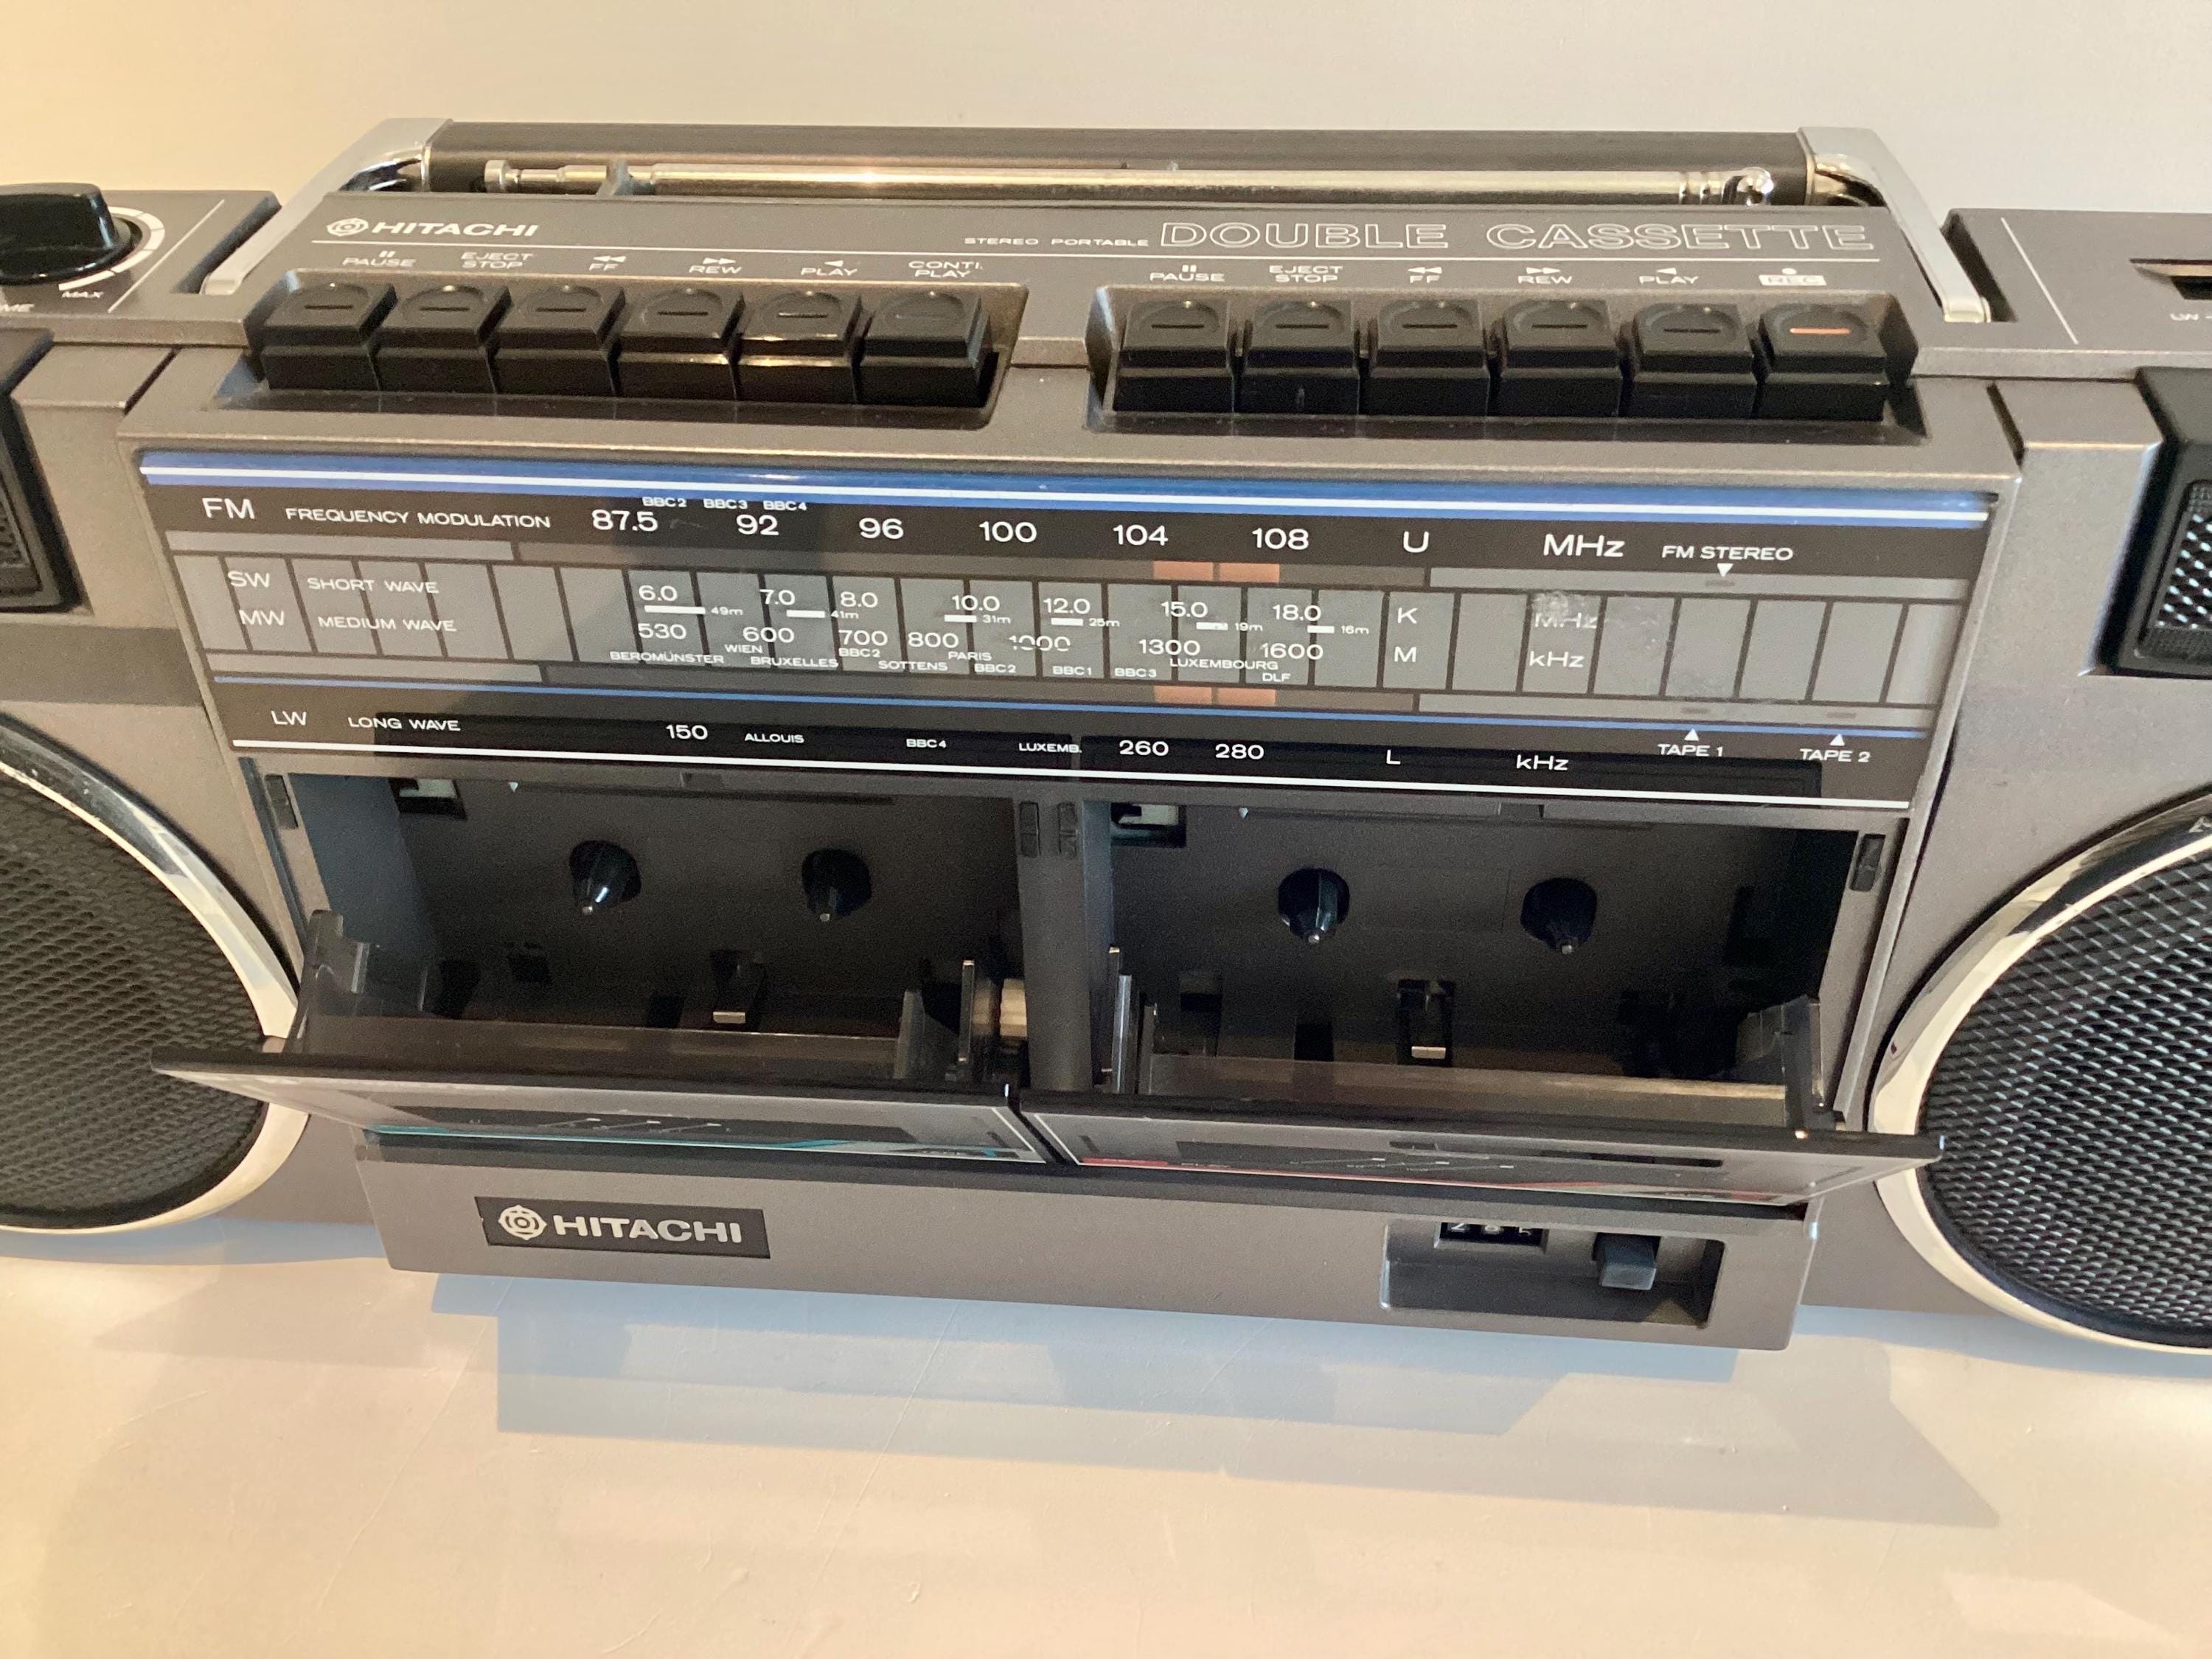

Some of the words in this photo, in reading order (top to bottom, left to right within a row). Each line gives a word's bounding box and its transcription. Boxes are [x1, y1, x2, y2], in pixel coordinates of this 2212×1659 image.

[372, 220, 540, 237] HITACHI
[1160, 221, 1449, 248] DOUBLE
[1486, 223, 1874, 250] CASSETTE
[964, 237, 1040, 245] STEREO
[1051, 238, 1149, 246] PORTABLE
[342, 257, 416, 268] PAUSE
[461, 251, 533, 261] EJECT
[462, 260, 523, 269] STOP
[589, 262, 617, 271] FF
[689, 265, 742, 274] REW
[800, 267, 858, 277] PLAY
[1269, 265, 1343, 274] EJECT
[914, 269, 971, 279] PLAY
[1150, 272, 1225, 282] PAUSE
[1274, 274, 1338, 283] STOP
[1410, 274, 1440, 284] FF
[1517, 275, 1573, 285] REW
[1638, 275, 1699, 285] PLAY
[202, 497, 255, 519] FM
[642, 496, 686, 508] BBC2
[703, 498, 748, 509] BBC3
[763, 500, 807, 512] BBC4
[285, 507, 408, 524] FREQUENCY
[417, 512, 551, 529] MODULATION
[591, 509, 658, 532] 87.5
[736, 514, 779, 536] 92
[858, 518, 904, 540] 96
[978, 521, 1037, 543] 100
[1113, 524, 1169, 546] 104
[1252, 528, 1309, 550] 108
[1402, 531, 1429, 554] U
[1543, 534, 1625, 557] MHz
[1662, 545, 1694, 559] FM
[1700, 546, 1793, 560] STEREO
[227, 571, 271, 588] SW
[306, 577, 374, 591] SHORT
[384, 580, 439, 594] WAVE
[638, 585, 678, 602] 6.0
[759, 589, 796, 606] 7.0
[840, 591, 878, 608] 8.0
[952, 594, 1001, 612] 10.0
[1043, 597, 1091, 614] 12.0
[1161, 601, 1208, 619] 15.0
[238, 609, 285, 626] MW
[711, 606, 743, 616] 49m
[830, 610, 859, 619] 41m
[1273, 604, 1321, 622] 18.0
[1397, 607, 1418, 625] K
[318, 616, 397, 630] MEDIUM
[402, 619, 457, 633] WAVE
[982, 614, 1011, 625] 31m
[1089, 617, 1120, 627] 25m
[1234, 622, 1263, 632] 19m
[1534, 612, 1598, 629] MHz
[638, 623, 686, 640] 530
[742, 627, 795, 644] 600
[1340, 625, 1369, 635] 16m
[838, 630, 888, 647] 700
[908, 632, 959, 649] 800
[1008, 635, 1071, 652] 1000
[725, 643, 763, 654] WIEN
[838, 647, 881, 658] BBC2
[1138, 639, 1200, 656] 1300
[1261, 643, 1324, 661] 1600
[1394, 647, 1417, 663] M
[609, 650, 724, 664] BEROMÜNSTER
[751, 655, 839, 669] BRUXELLES
[948, 650, 992, 661] PARIS
[1529, 651, 1585, 668] kHz
[878, 660, 948, 672] SOTTENS
[974, 663, 1017, 674] BBC2
[1052, 665, 1092, 676] BBC1
[1169, 658, 1279, 671] LUXEMBOURG
[1114, 667, 1157, 678] BBC3
[1262, 672, 1291, 683] DLF
[271, 710, 307, 726] LW
[348, 717, 403, 730] LONG
[408, 718, 461, 732] WAVE
[666, 724, 708, 741] 150
[744, 733, 804, 744] ALLOUIS
[906, 739, 947, 749] BBC4
[1018, 742, 1082, 754] LUXEMB.
[1119, 740, 1169, 757] 260
[1658, 743, 1711, 757] TAPE
[1716, 746, 1723, 758] 1
[1215, 743, 1265, 761] 280
[1386, 749, 1401, 765] L
[1800, 748, 1854, 762] TAPE
[1857, 751, 1871, 763] 2
[1516, 754, 1569, 771] kHz
[553, 1213, 742, 1245] HITACHI
